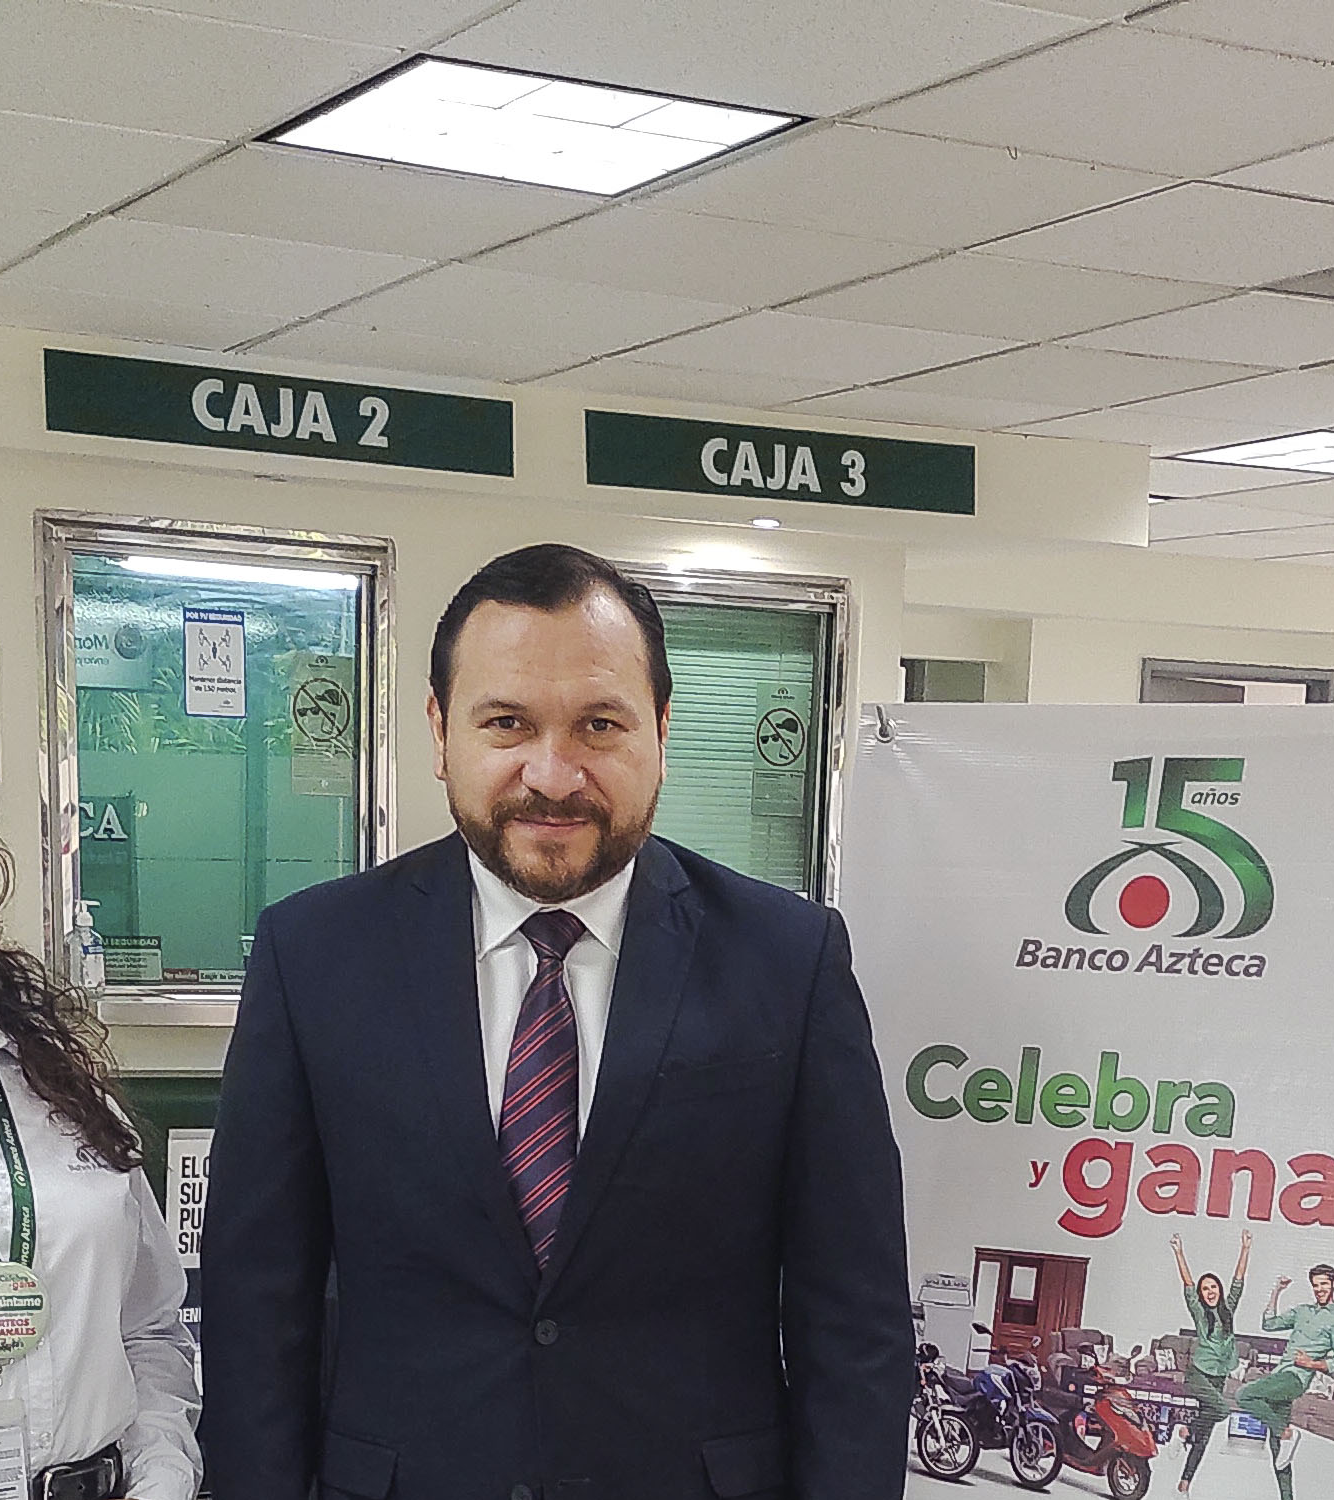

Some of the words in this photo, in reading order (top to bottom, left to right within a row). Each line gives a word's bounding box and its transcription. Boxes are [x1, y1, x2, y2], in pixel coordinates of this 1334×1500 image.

[192, 378, 337, 444] CAJA
[357, 396, 390, 448] 2
[701, 437, 822, 493] CAJA
[839, 449, 866, 497] 3
[1189, 785, 1242, 806] años
[1014, 939, 1129, 973] Banco
[1135, 942, 1267, 979] Azteca
[904, 1043, 1236, 1140] Celebra
[181, 1156, 200, 1180] EL
[1028, 1155, 1050, 1188] y
[21, 1206, 31, 1241] Azteca
